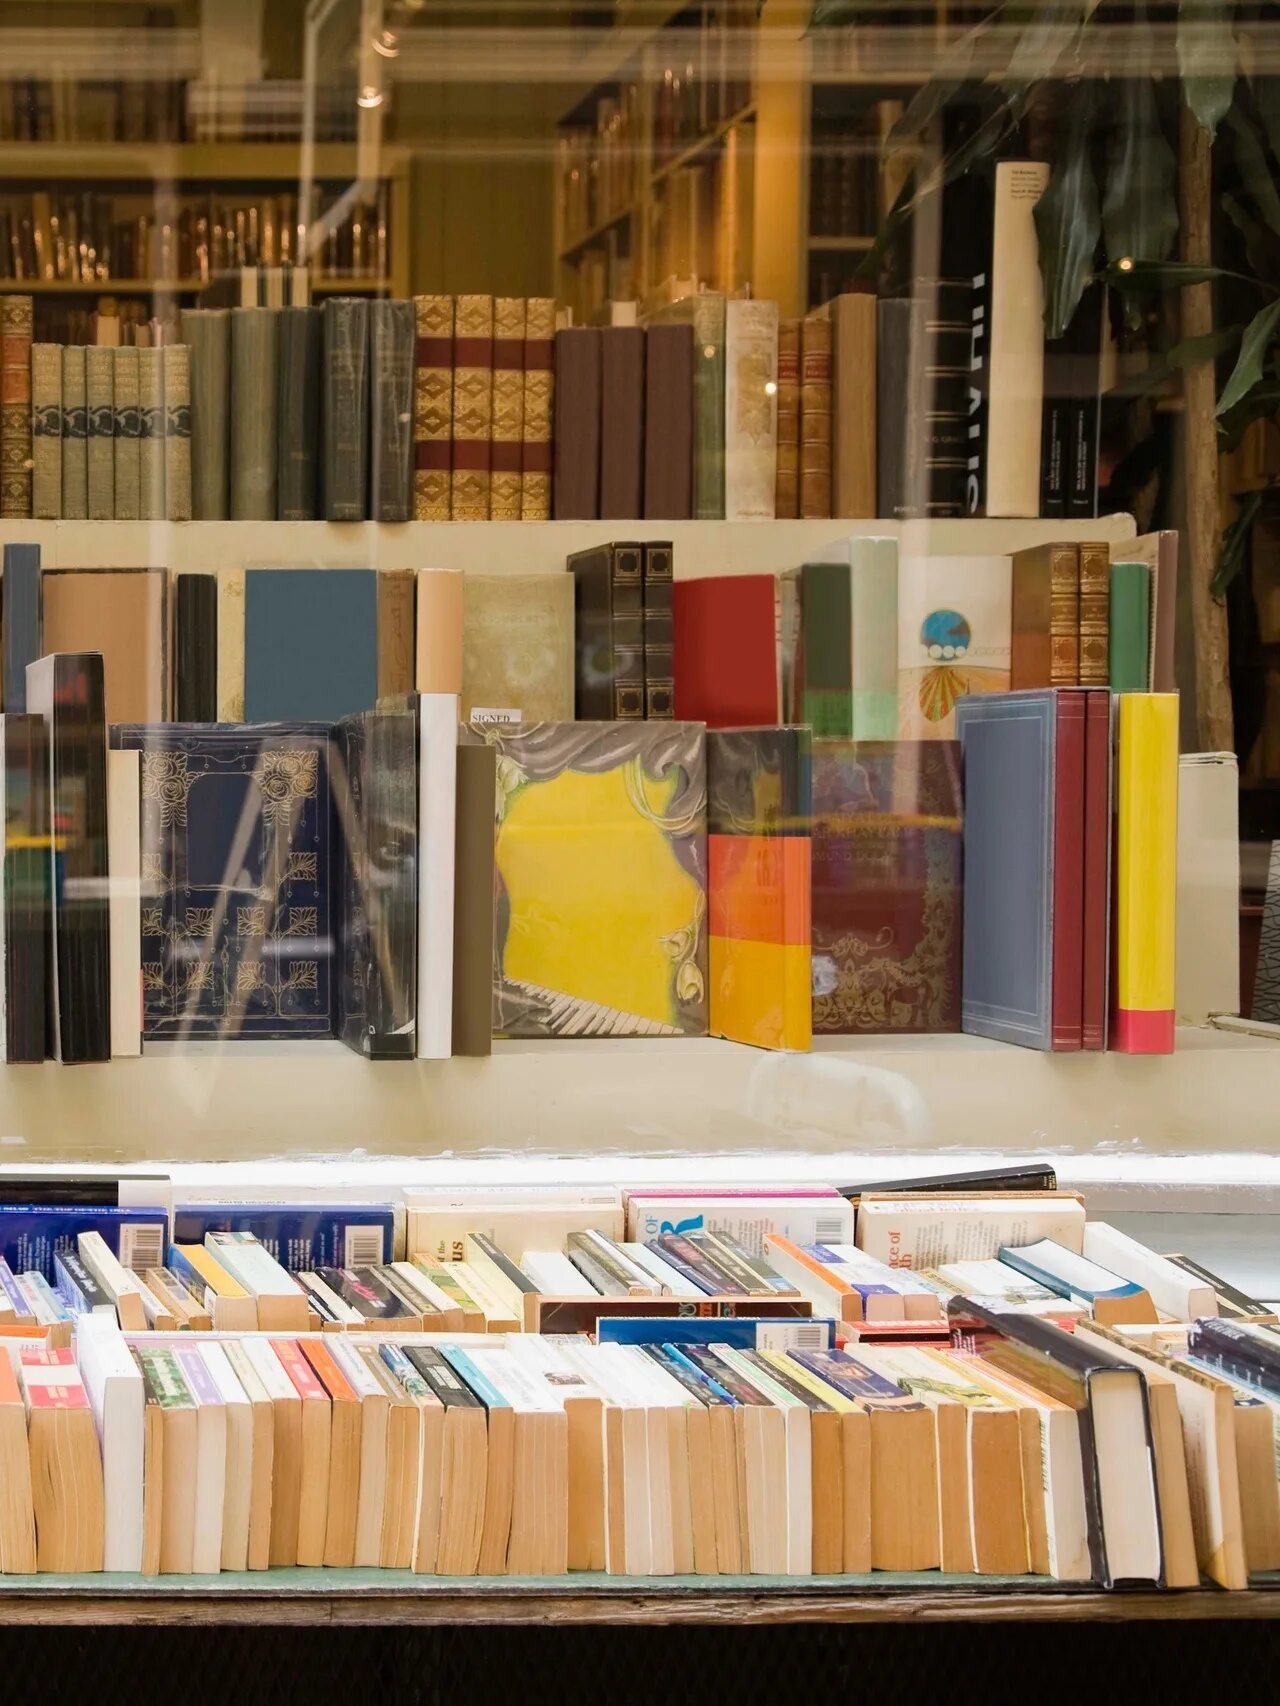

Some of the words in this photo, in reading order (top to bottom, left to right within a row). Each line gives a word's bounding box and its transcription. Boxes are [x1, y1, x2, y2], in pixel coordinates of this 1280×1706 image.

[472, 715, 511, 724] SIGNED
[646, 1216, 658, 1234] OF
[888, 1231, 900, 1244] of
[452, 1241, 464, 1262] us
